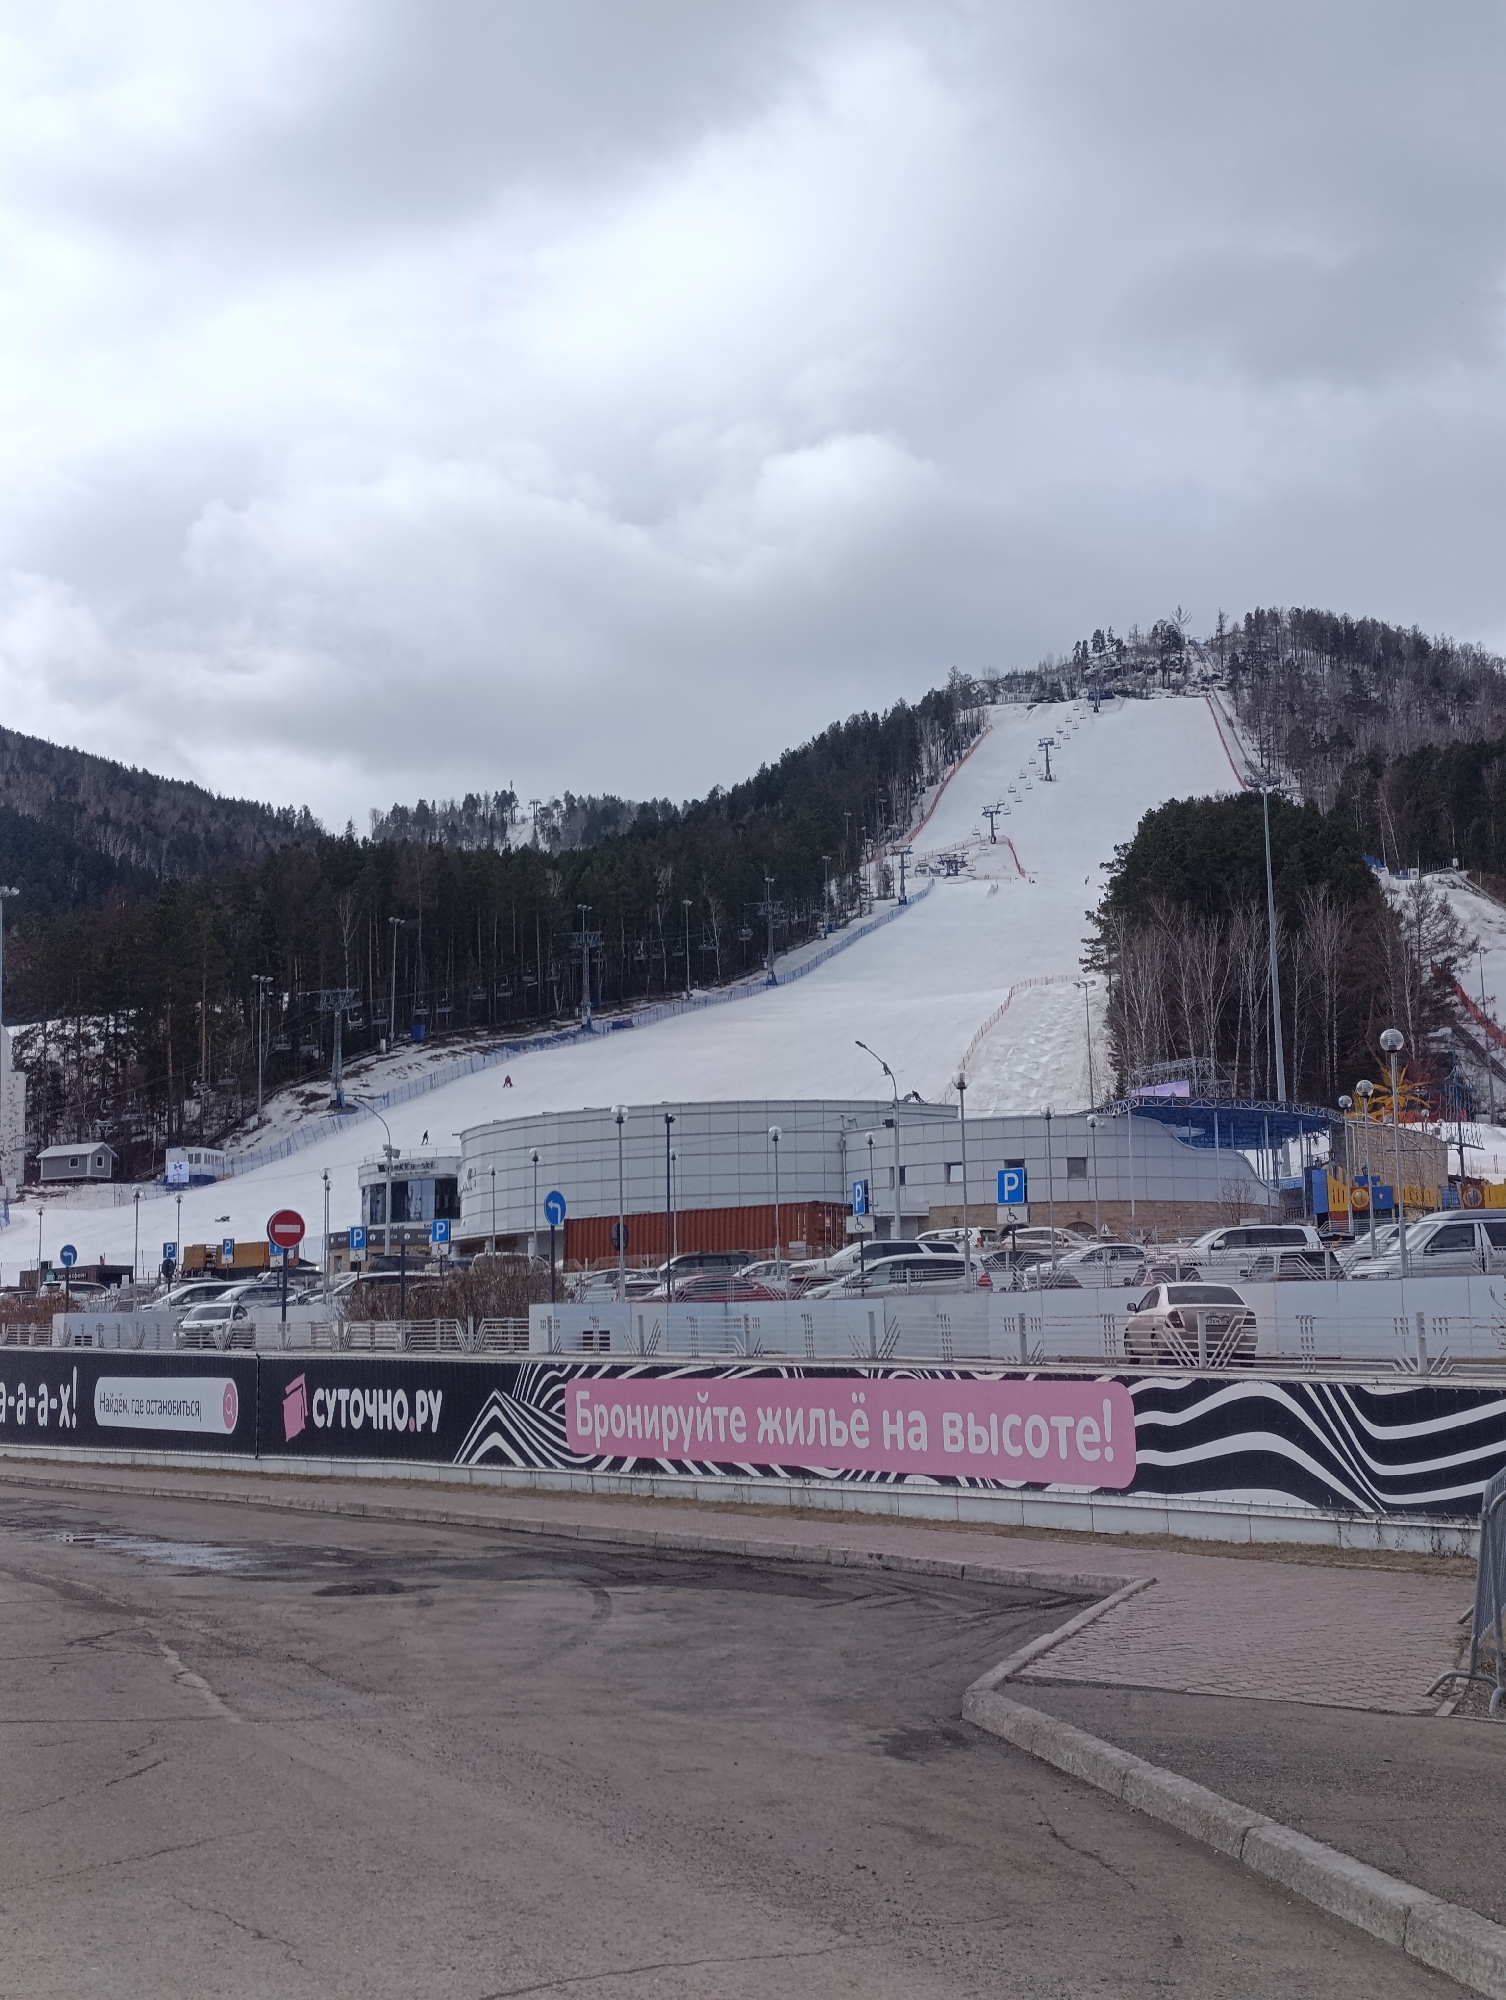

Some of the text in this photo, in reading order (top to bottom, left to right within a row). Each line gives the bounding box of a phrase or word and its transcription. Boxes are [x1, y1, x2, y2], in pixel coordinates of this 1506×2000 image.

[855, 1184, 862, 1211] P
[1004, 1173, 1019, 1200] P
[353, 1228, 363, 1247] P
[436, 1222, 446, 1240] P
[131, 1398, 144, 1418] где
[146, 1399, 200, 1418] остановиться
[312, 1387, 443, 1433] СУТОЧНО.РУ
[576, 1390, 1114, 1463] Бронируйте жильё на высоте!
